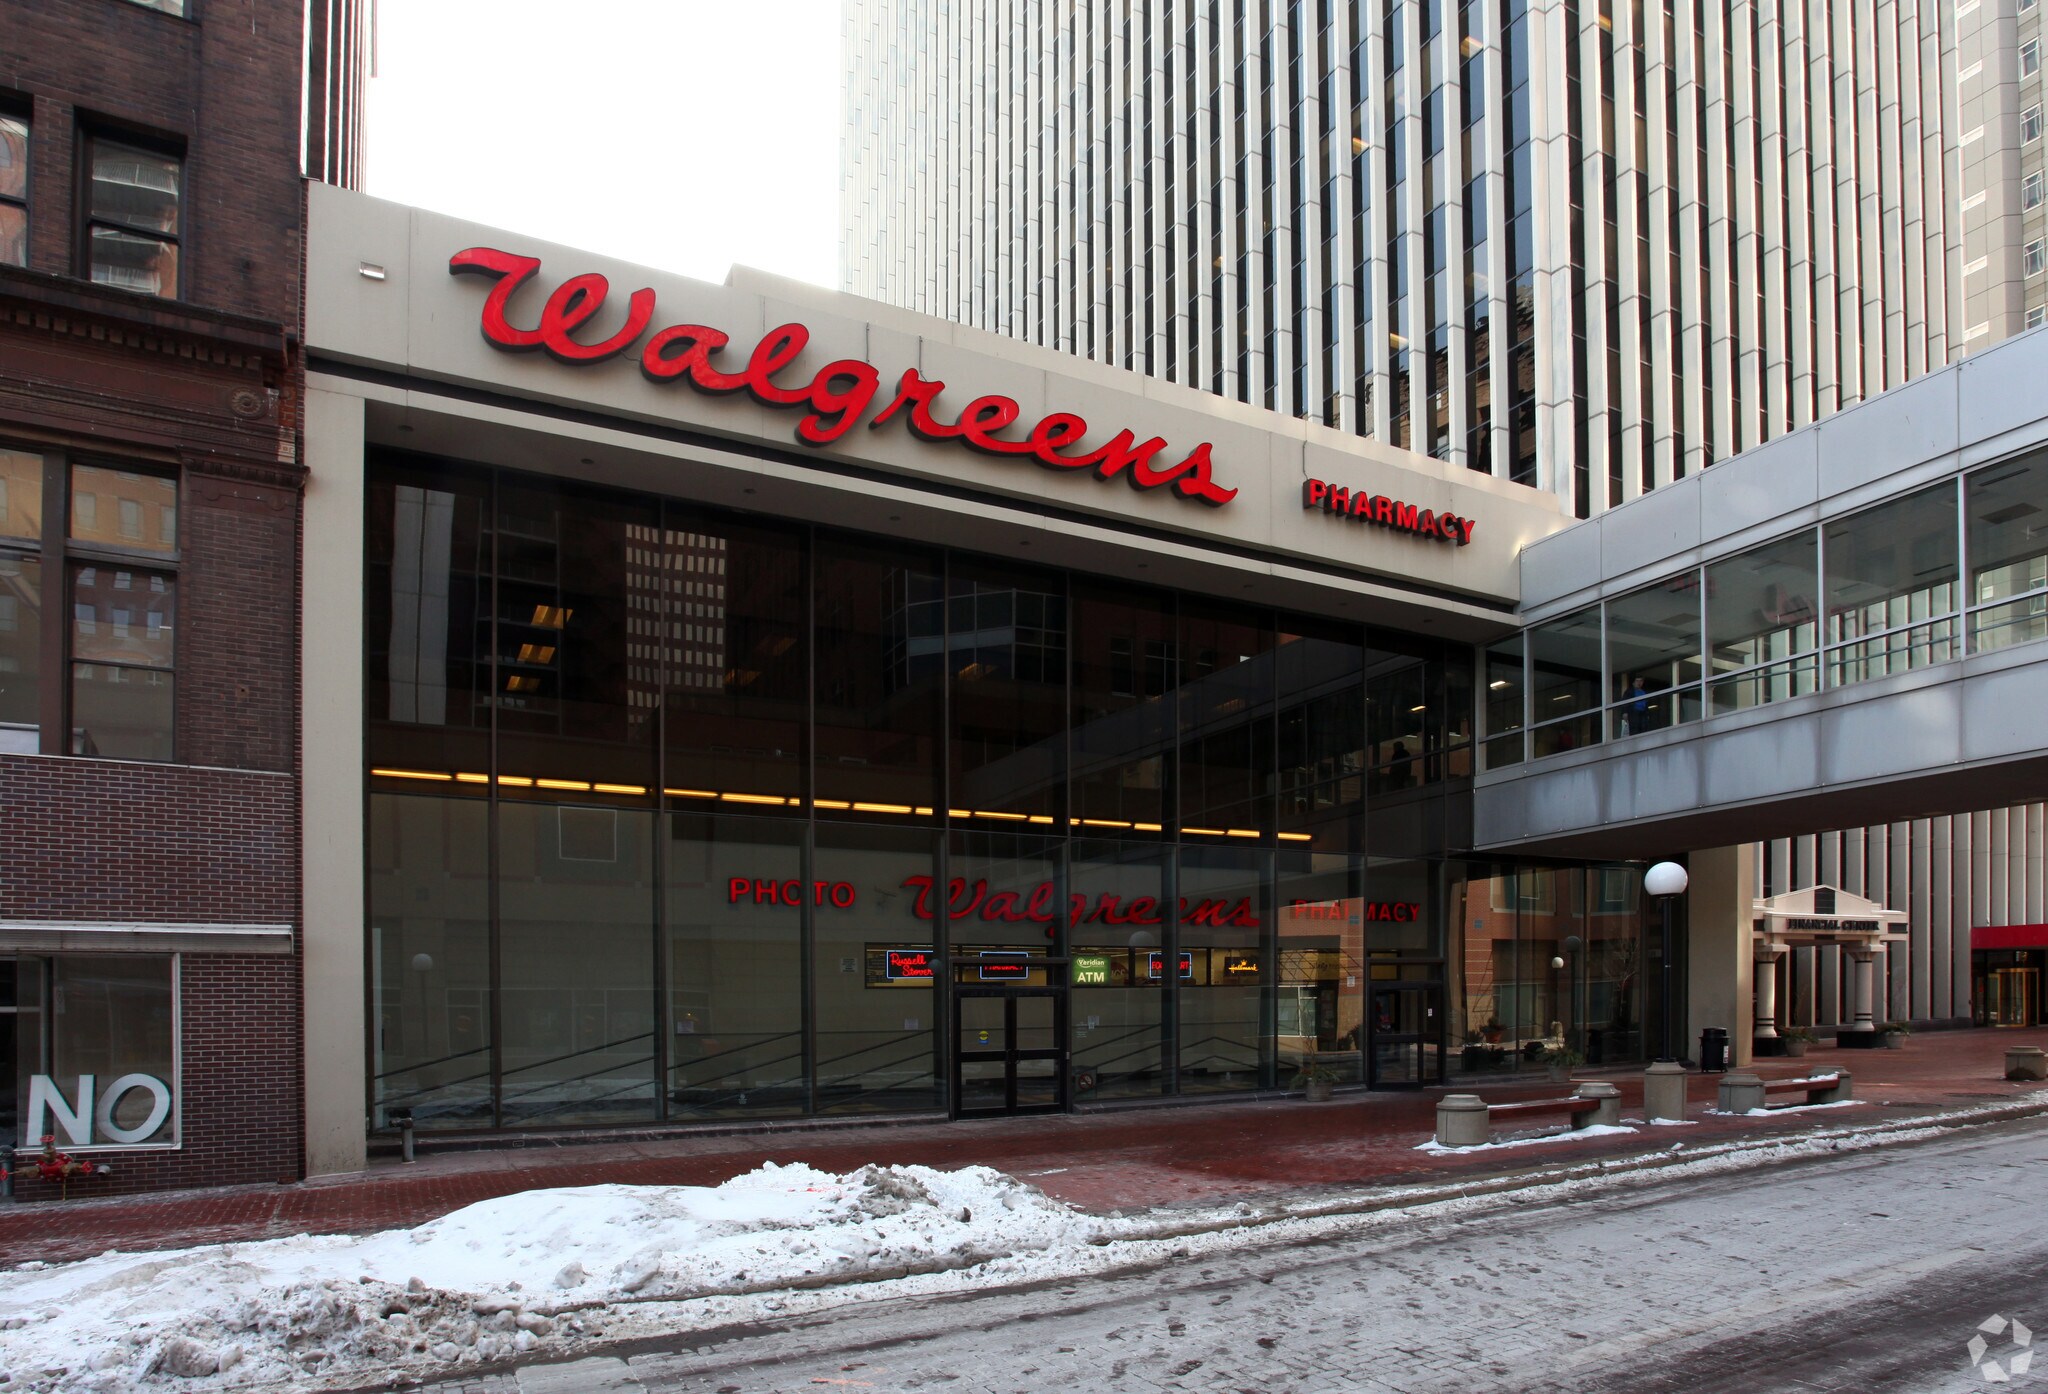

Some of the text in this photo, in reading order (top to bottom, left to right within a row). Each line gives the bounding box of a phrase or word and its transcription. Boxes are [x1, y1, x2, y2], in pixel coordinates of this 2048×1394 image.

[449, 246, 1238, 510] Walgreens
[1303, 478, 1476, 547] PHARMACY
[729, 877, 856, 908] PHOTO
[1788, 919, 1879, 931] FINANCIAL CENTER
[890, 953, 927, 967] Russell
[1076, 958, 1105, 968] Veridian
[902, 964, 934, 977] Stover
[1228, 963, 1260, 973] Hallmark
[1076, 972, 1105, 983] ATM
[26, 1072, 172, 1146] NO
